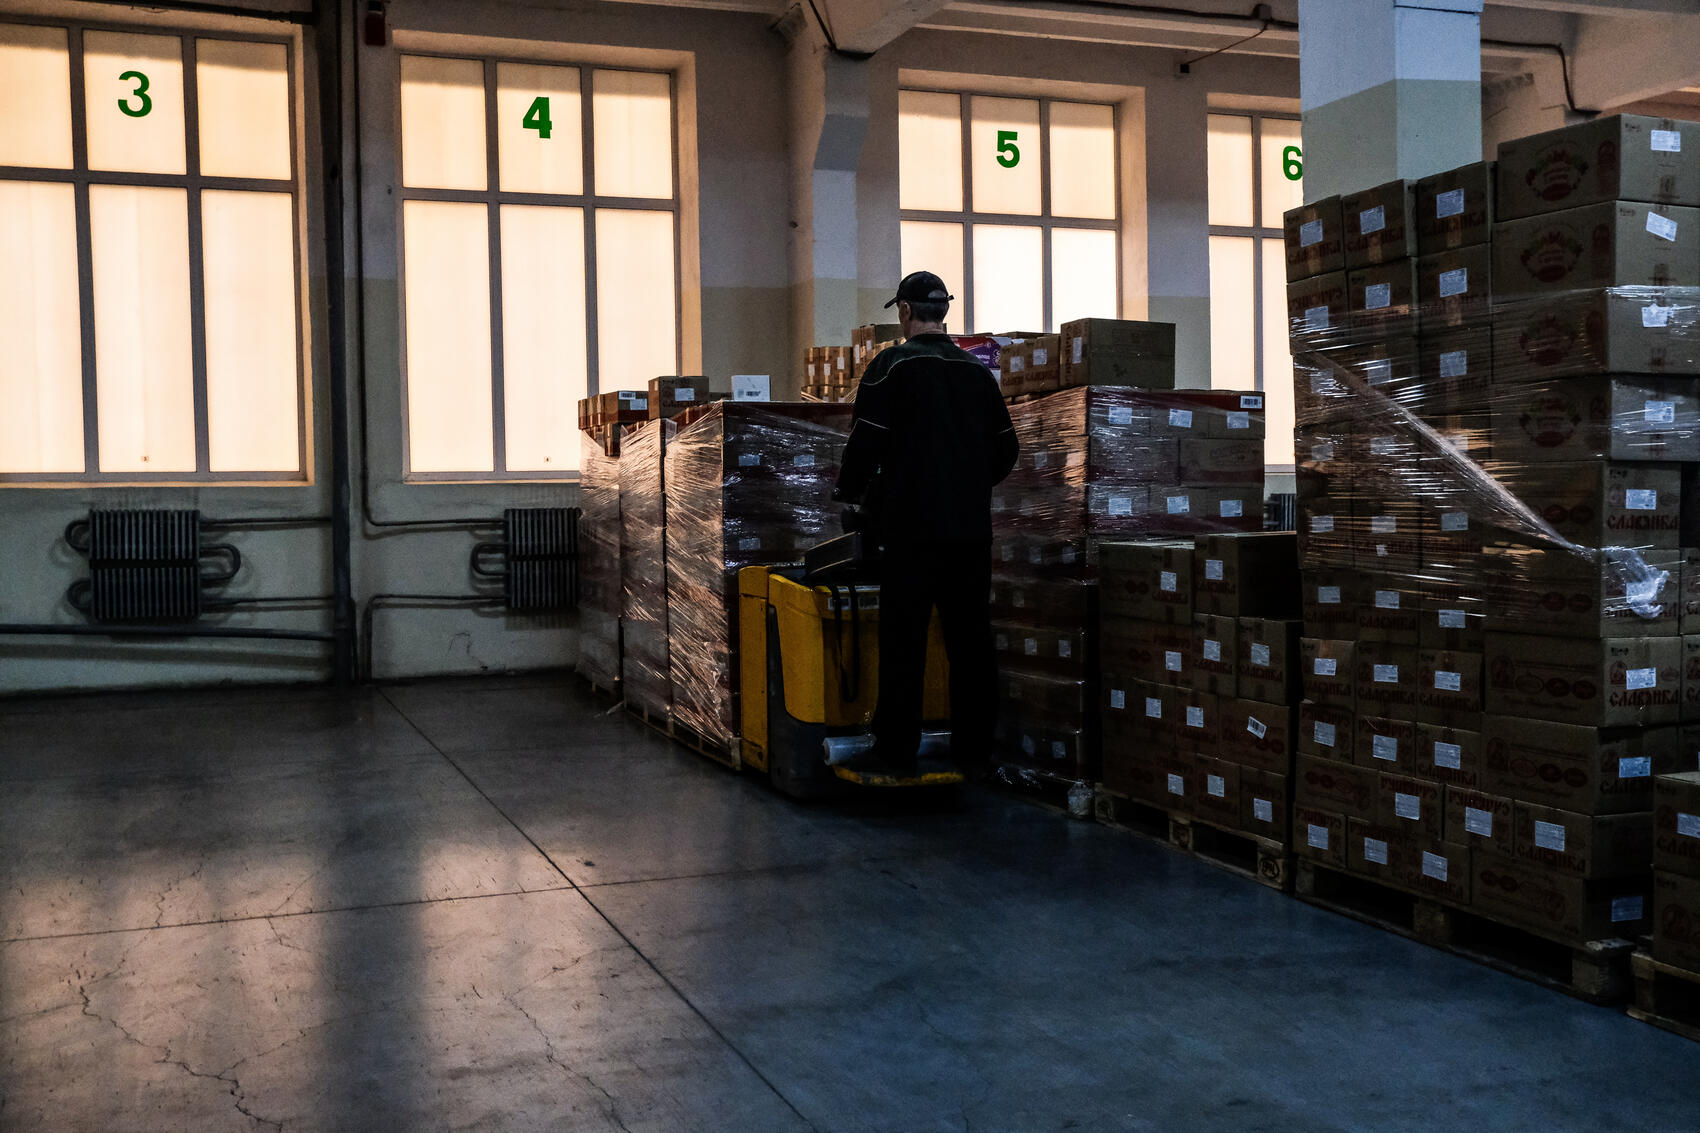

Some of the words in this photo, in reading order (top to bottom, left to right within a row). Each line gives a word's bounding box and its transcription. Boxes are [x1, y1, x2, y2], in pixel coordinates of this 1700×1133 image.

[119, 72, 151, 116] 3
[523, 98, 552, 138] 4
[997, 131, 1020, 168] 5
[1283, 146, 1303, 181] 6
